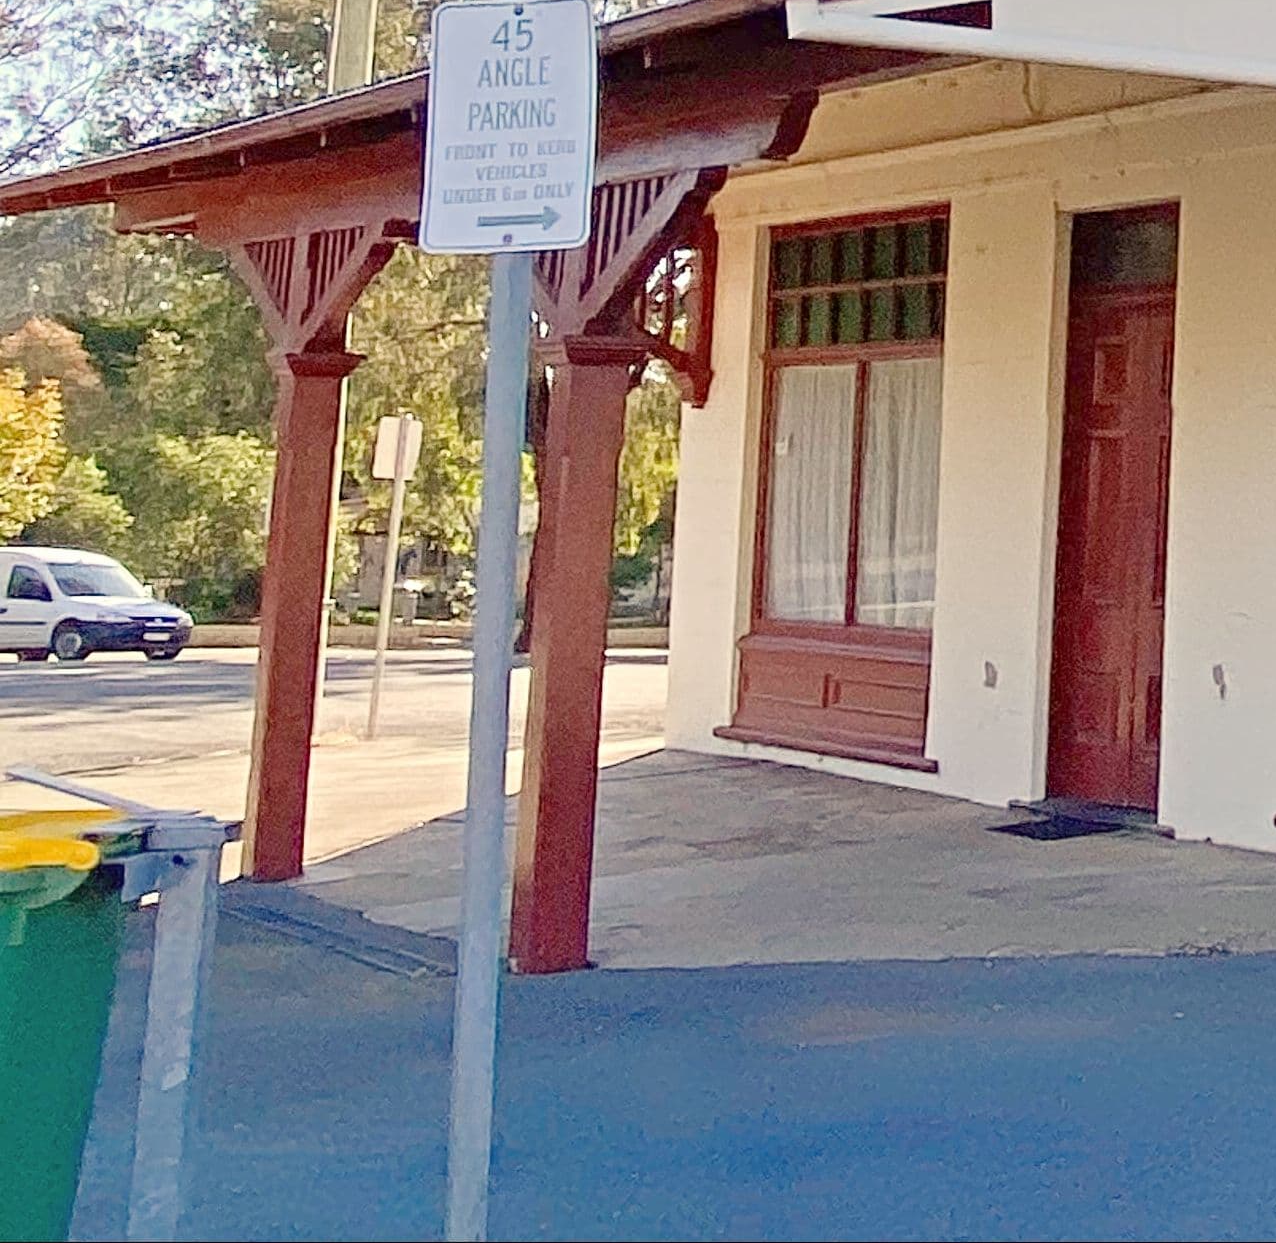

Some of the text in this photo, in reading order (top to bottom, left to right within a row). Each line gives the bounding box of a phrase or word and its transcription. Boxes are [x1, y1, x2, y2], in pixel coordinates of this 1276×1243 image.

[491, 19, 534, 52] 45
[477, 57, 551, 87] ANGLE
[467, 99, 556, 131] PARKING
[445, 143, 497, 160] FRONT
[508, 142, 528, 158] TO
[475, 163, 548, 180] VEHICLES
[443, 187, 497, 204] UNDER
[533, 181, 574, 199] ONLY
